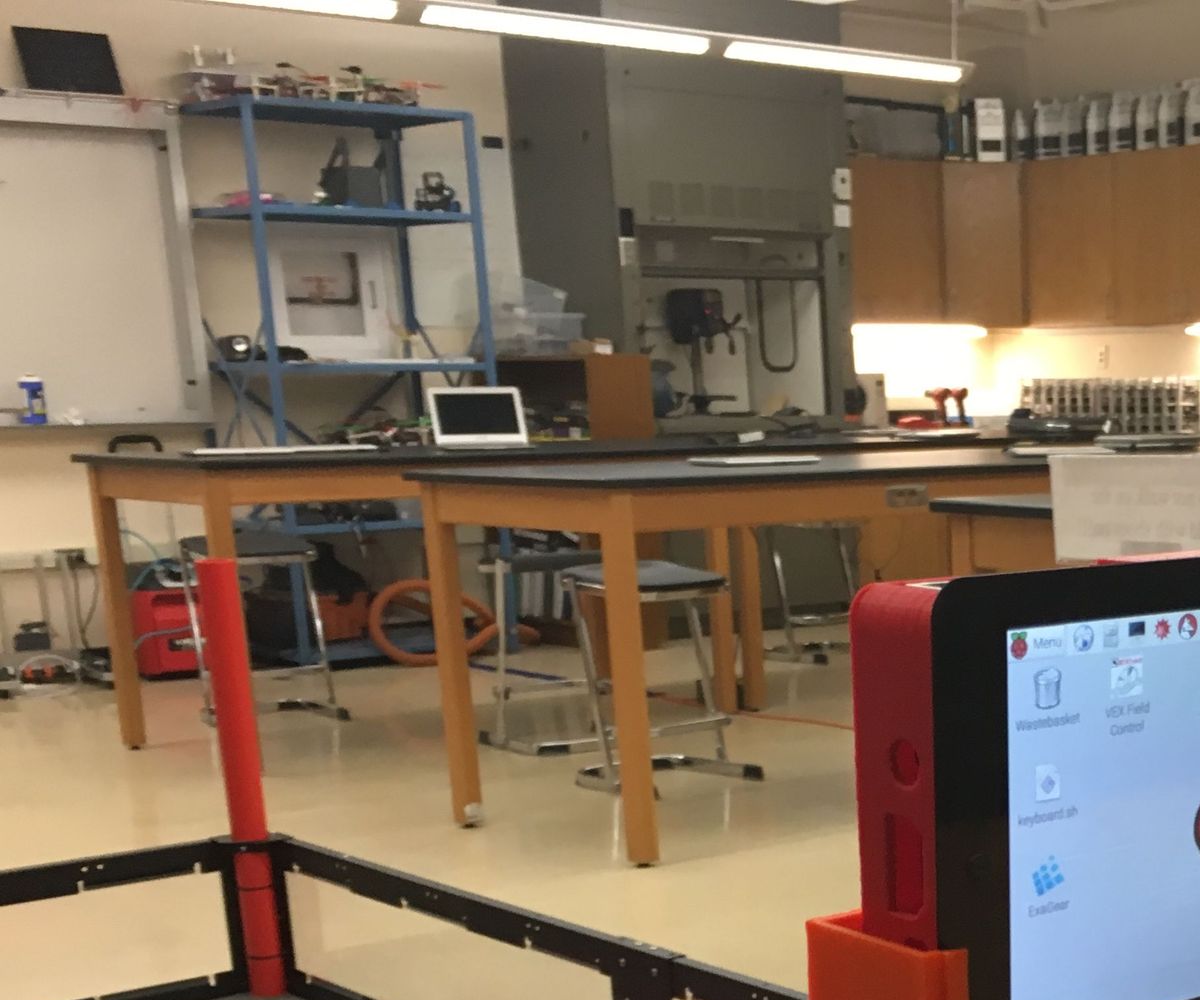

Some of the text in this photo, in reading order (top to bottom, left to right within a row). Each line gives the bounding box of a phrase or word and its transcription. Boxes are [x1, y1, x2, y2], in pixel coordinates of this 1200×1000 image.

[1033, 637, 1063, 650] Menu
[1105, 701, 1150, 719] VEX Field
[1015, 712, 1081, 732] Wastebasket
[1110, 720, 1145, 736] Control
[1018, 805, 1079, 828] keyboard.sh
